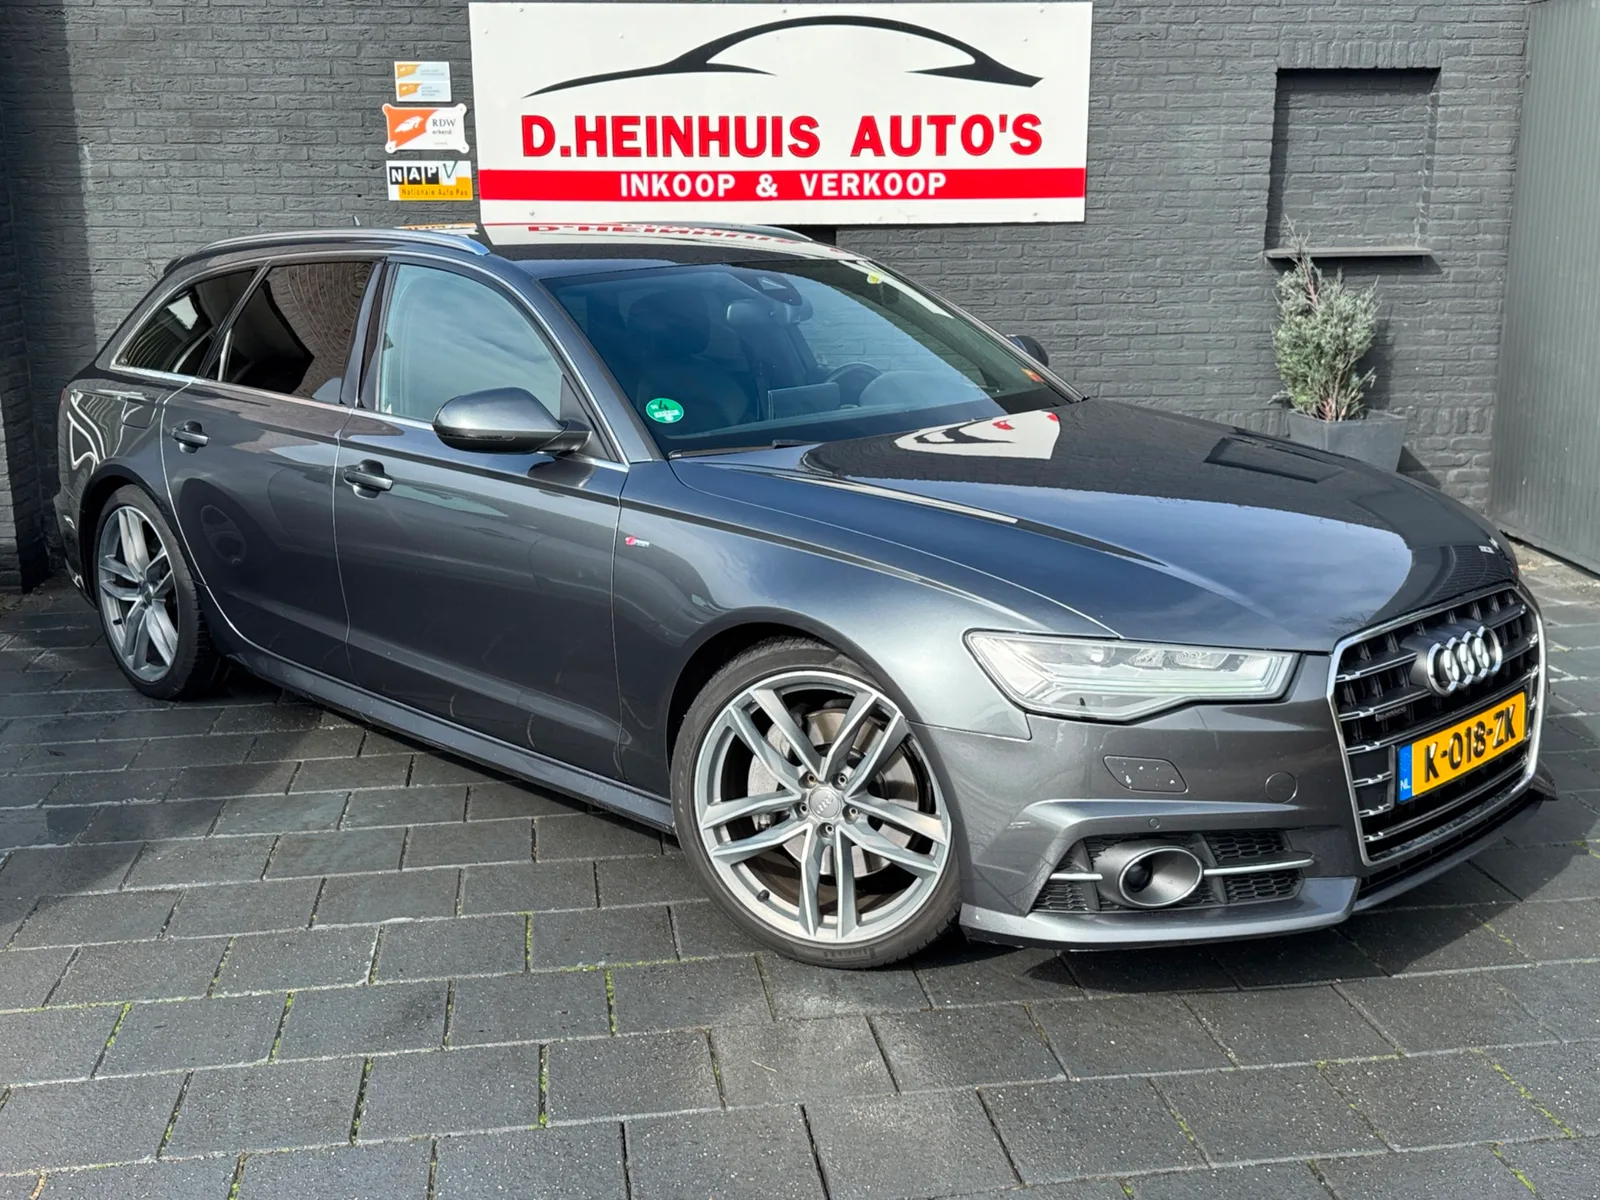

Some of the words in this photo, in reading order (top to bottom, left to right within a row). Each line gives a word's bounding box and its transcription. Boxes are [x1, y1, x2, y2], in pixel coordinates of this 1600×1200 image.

[432, 118, 456, 127] RDW
[521, 115, 821, 158] D.HEINHUIS
[851, 113, 1042, 157] AUTO'S
[391, 166, 438, 182] NAP
[401, 188, 435, 196] Nationale
[438, 188, 454, 196] Auto
[620, 173, 735, 197] INKOOP
[755, 174, 778, 197] &
[800, 172, 946, 197] VERKOOP
[1425, 704, 1516, 783] K-018-ZK
[1400, 778, 1411, 791] NL
